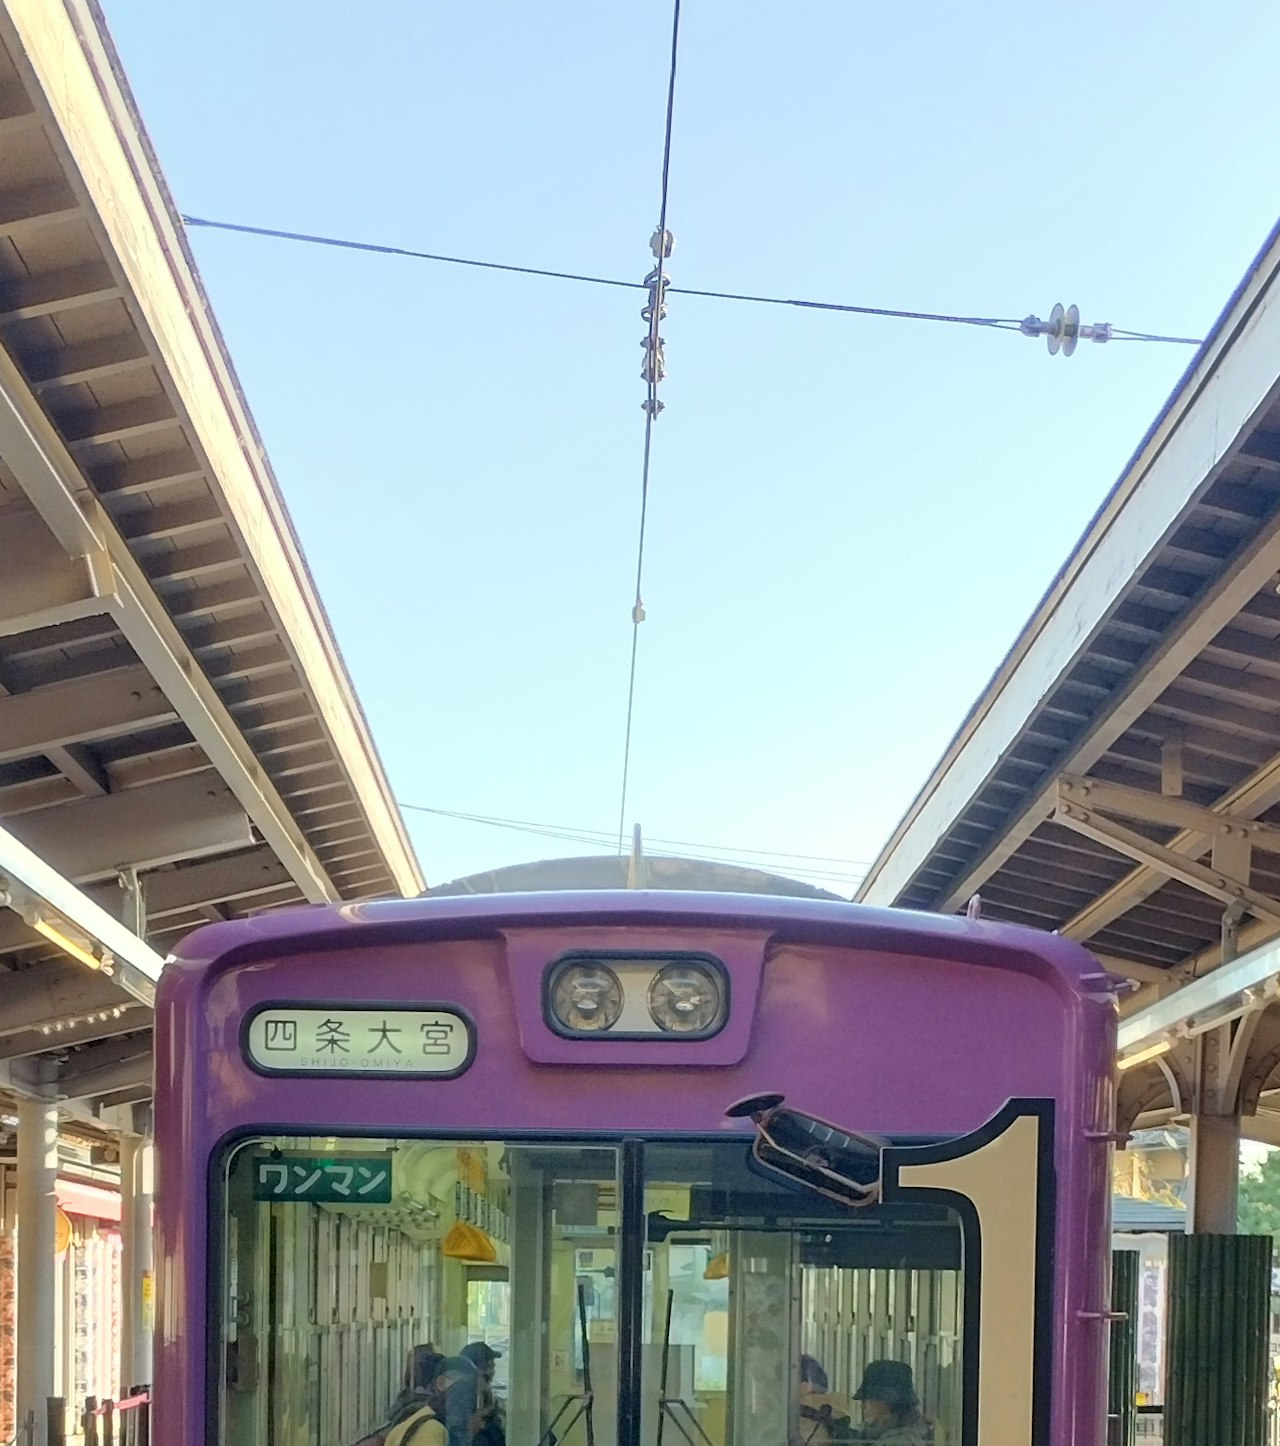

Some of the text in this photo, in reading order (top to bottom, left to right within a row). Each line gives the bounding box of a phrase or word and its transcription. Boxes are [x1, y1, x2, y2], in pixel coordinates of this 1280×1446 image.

[264, 1018, 454, 1055] 四条大宮
[300, 1057, 414, 1069] SHIJO-OMIYA
[258, 1164, 387, 1196] ワンマン
